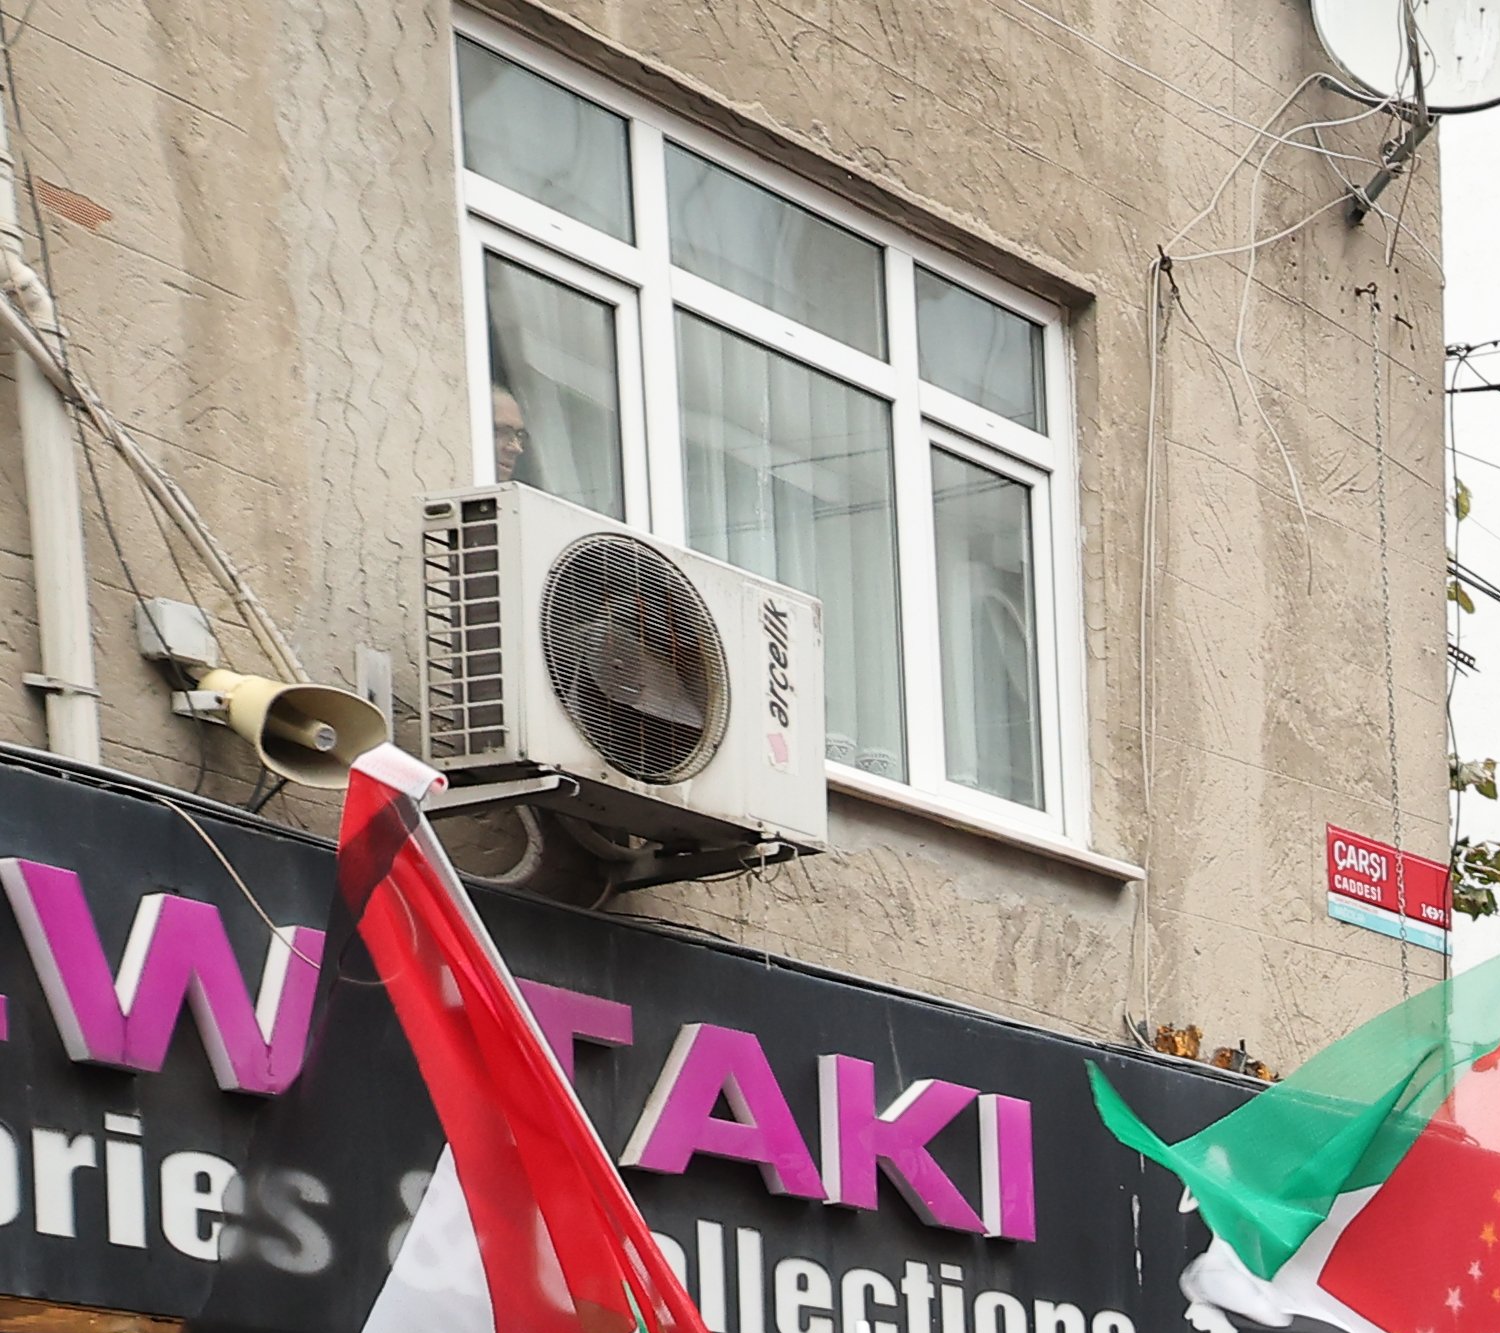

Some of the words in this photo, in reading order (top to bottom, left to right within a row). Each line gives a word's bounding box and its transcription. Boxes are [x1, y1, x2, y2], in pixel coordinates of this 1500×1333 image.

[763, 597, 795, 729] arçelik
[1333, 840, 1388, 883] ÇARŞI
[0, 856, 329, 1097] W
